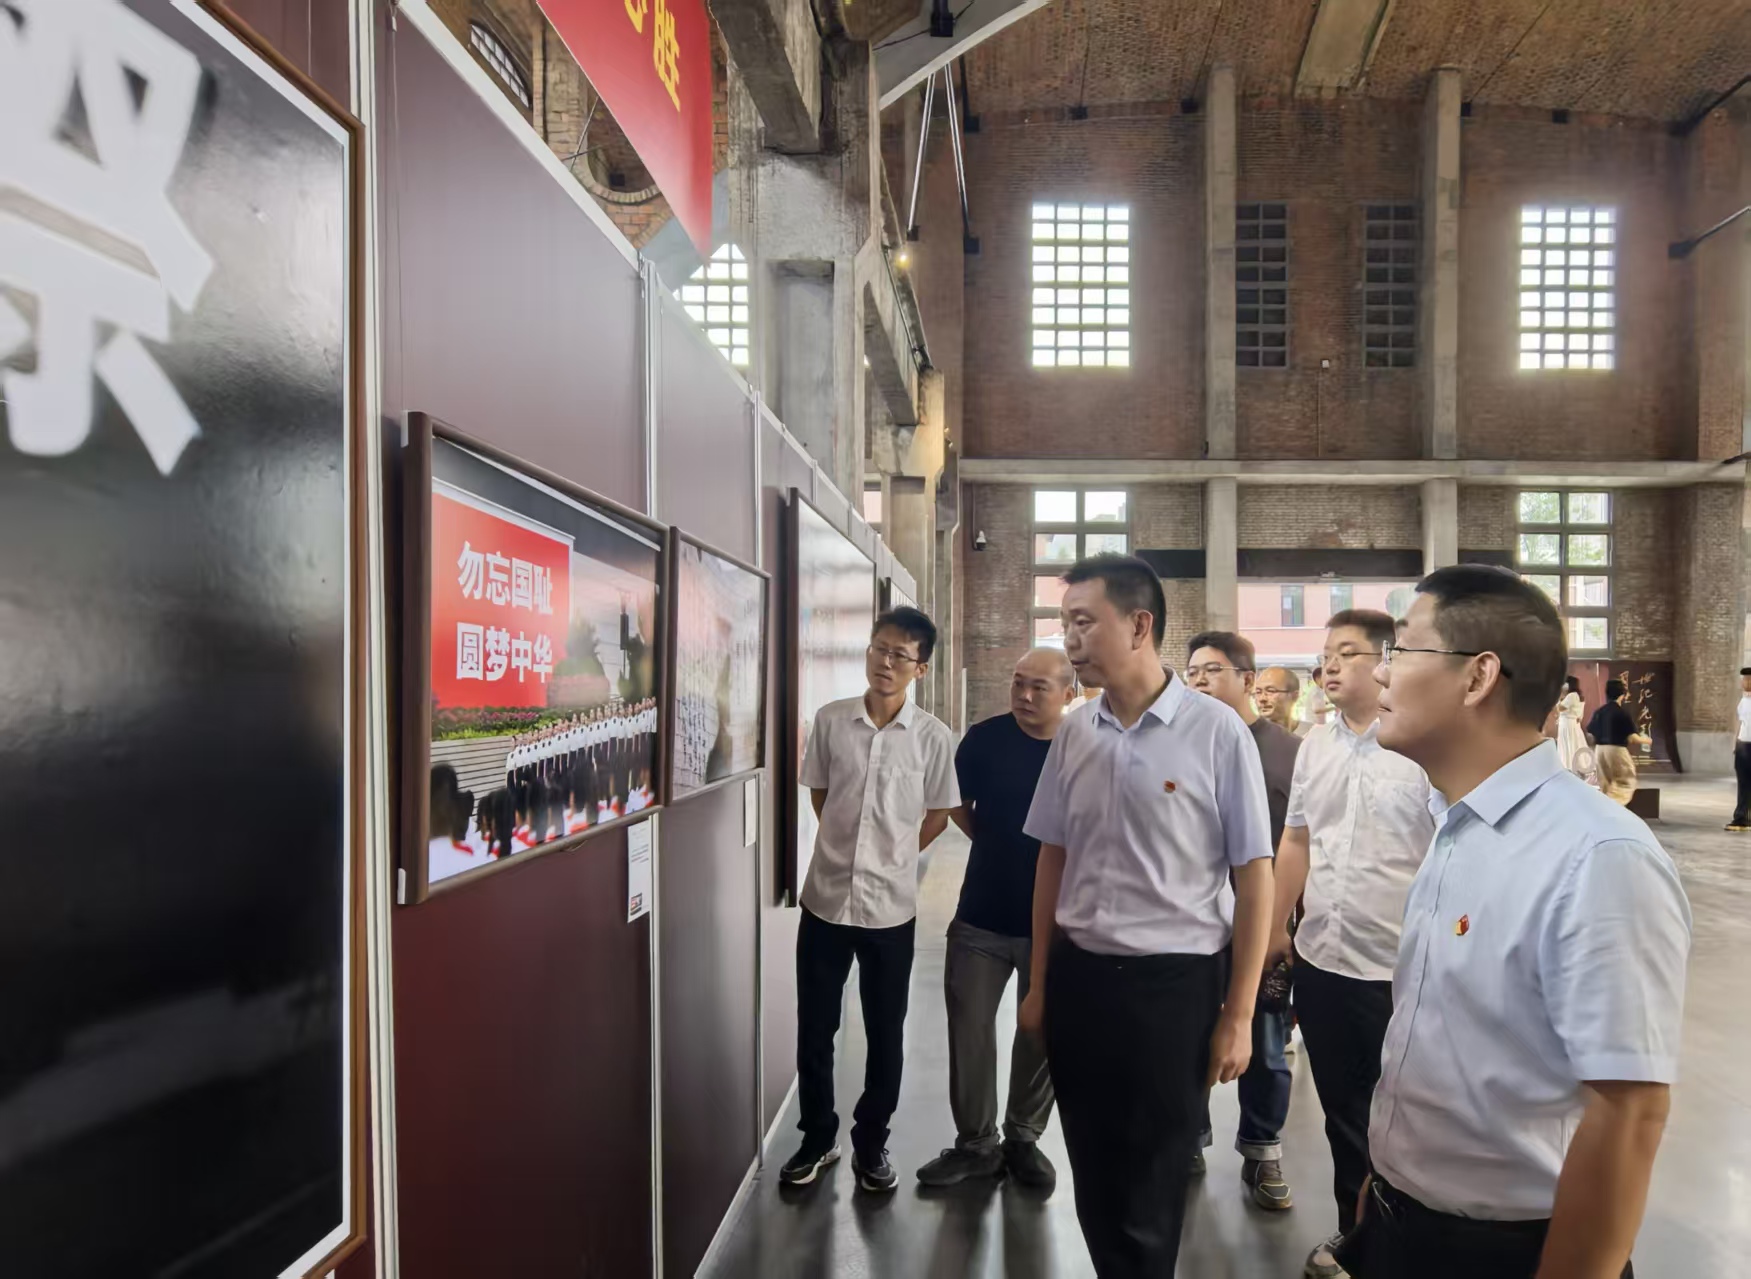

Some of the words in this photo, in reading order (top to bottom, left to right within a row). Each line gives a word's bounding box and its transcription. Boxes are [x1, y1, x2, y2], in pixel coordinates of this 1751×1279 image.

[457, 541, 553, 615] 勿忘国耻
[456, 622, 553, 683] 圆梦中华
